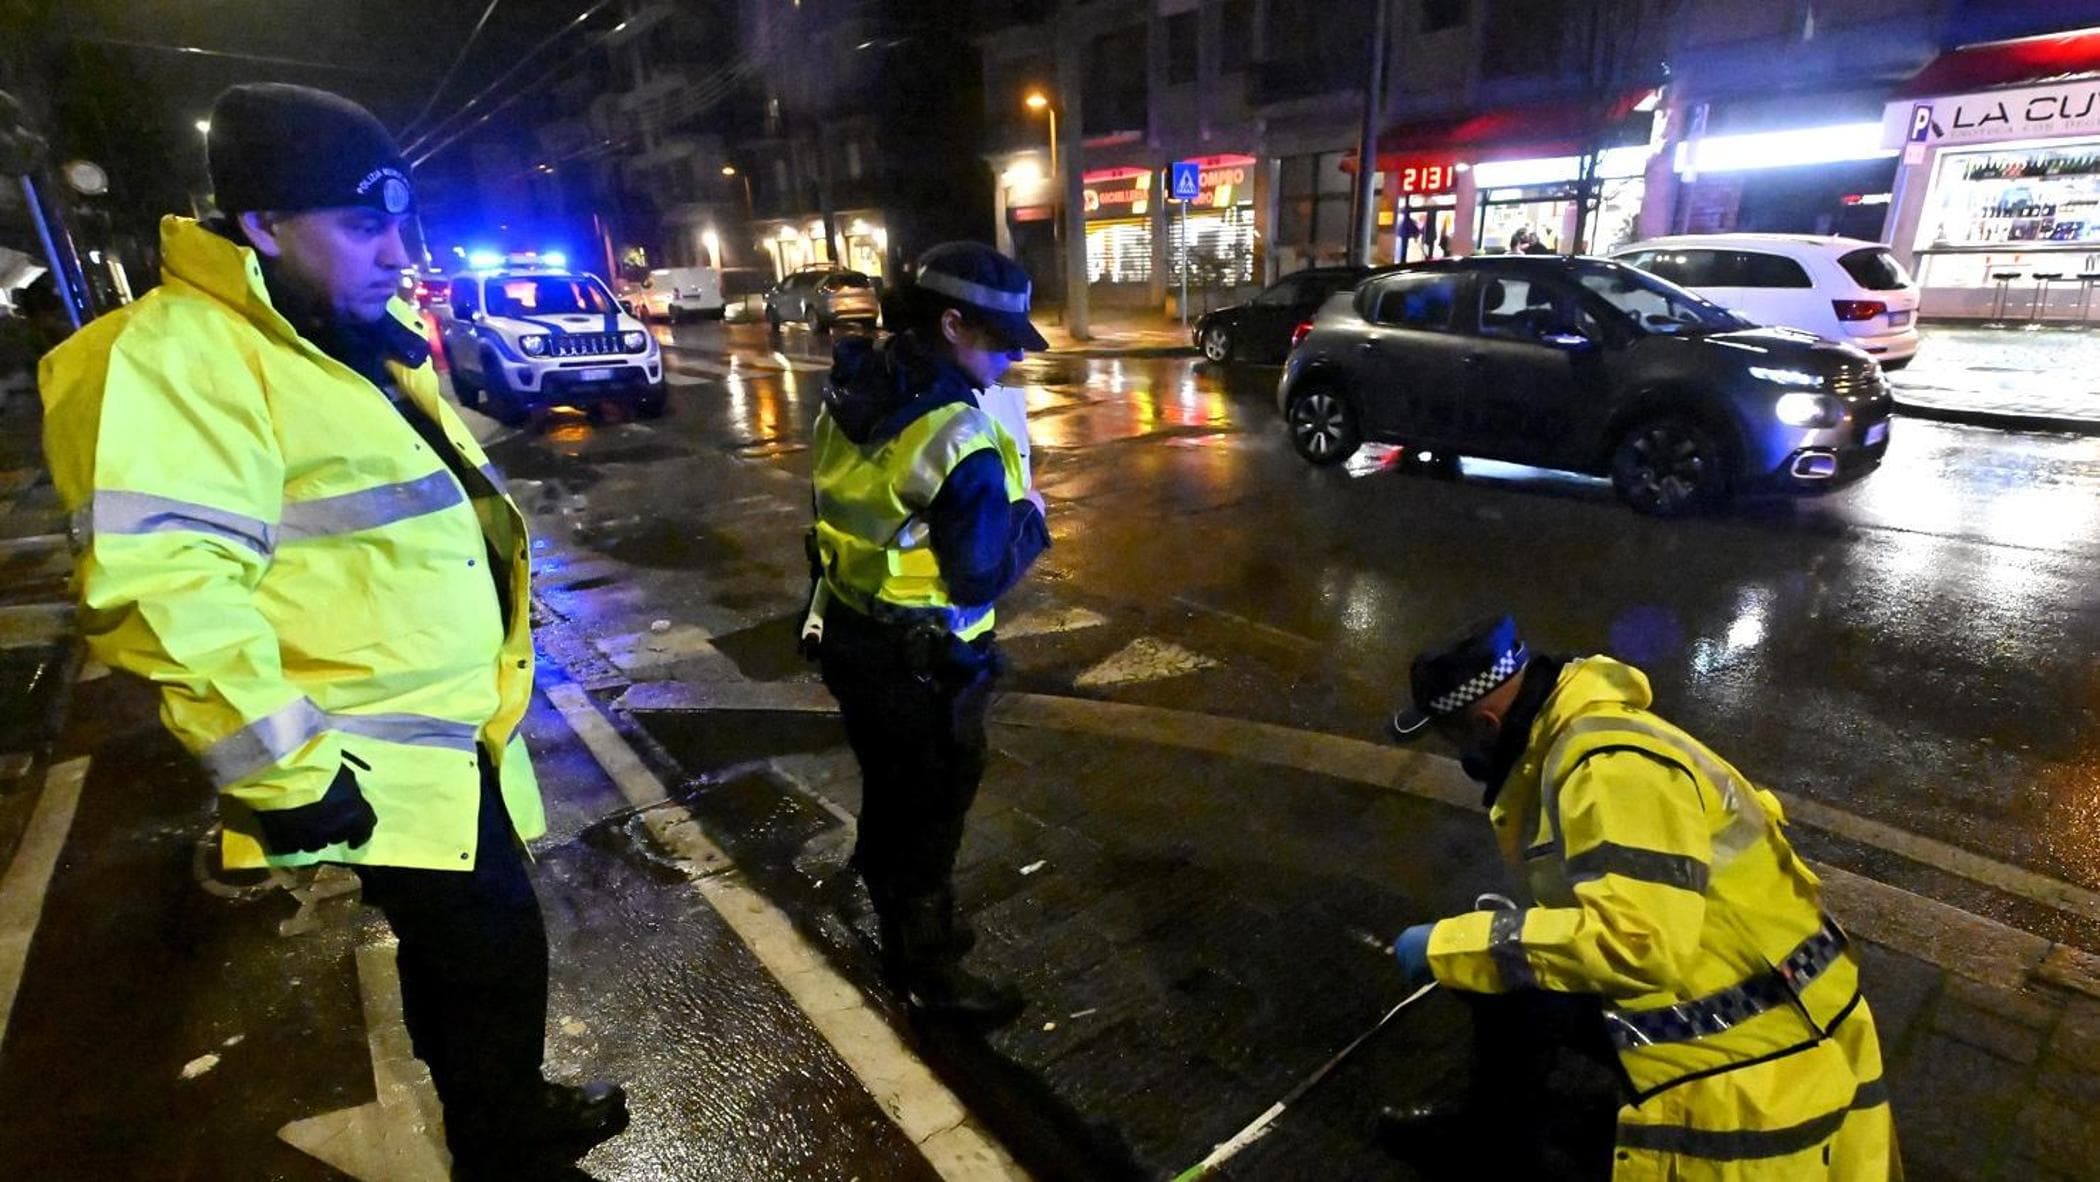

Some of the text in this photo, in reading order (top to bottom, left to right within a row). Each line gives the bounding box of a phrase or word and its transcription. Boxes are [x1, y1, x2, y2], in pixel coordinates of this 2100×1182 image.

[1911, 107, 1930, 139] P
[1953, 92, 2100, 128] LA CU
[1199, 168, 1245, 188] OMPRO
[1403, 167, 1453, 191] 2131
